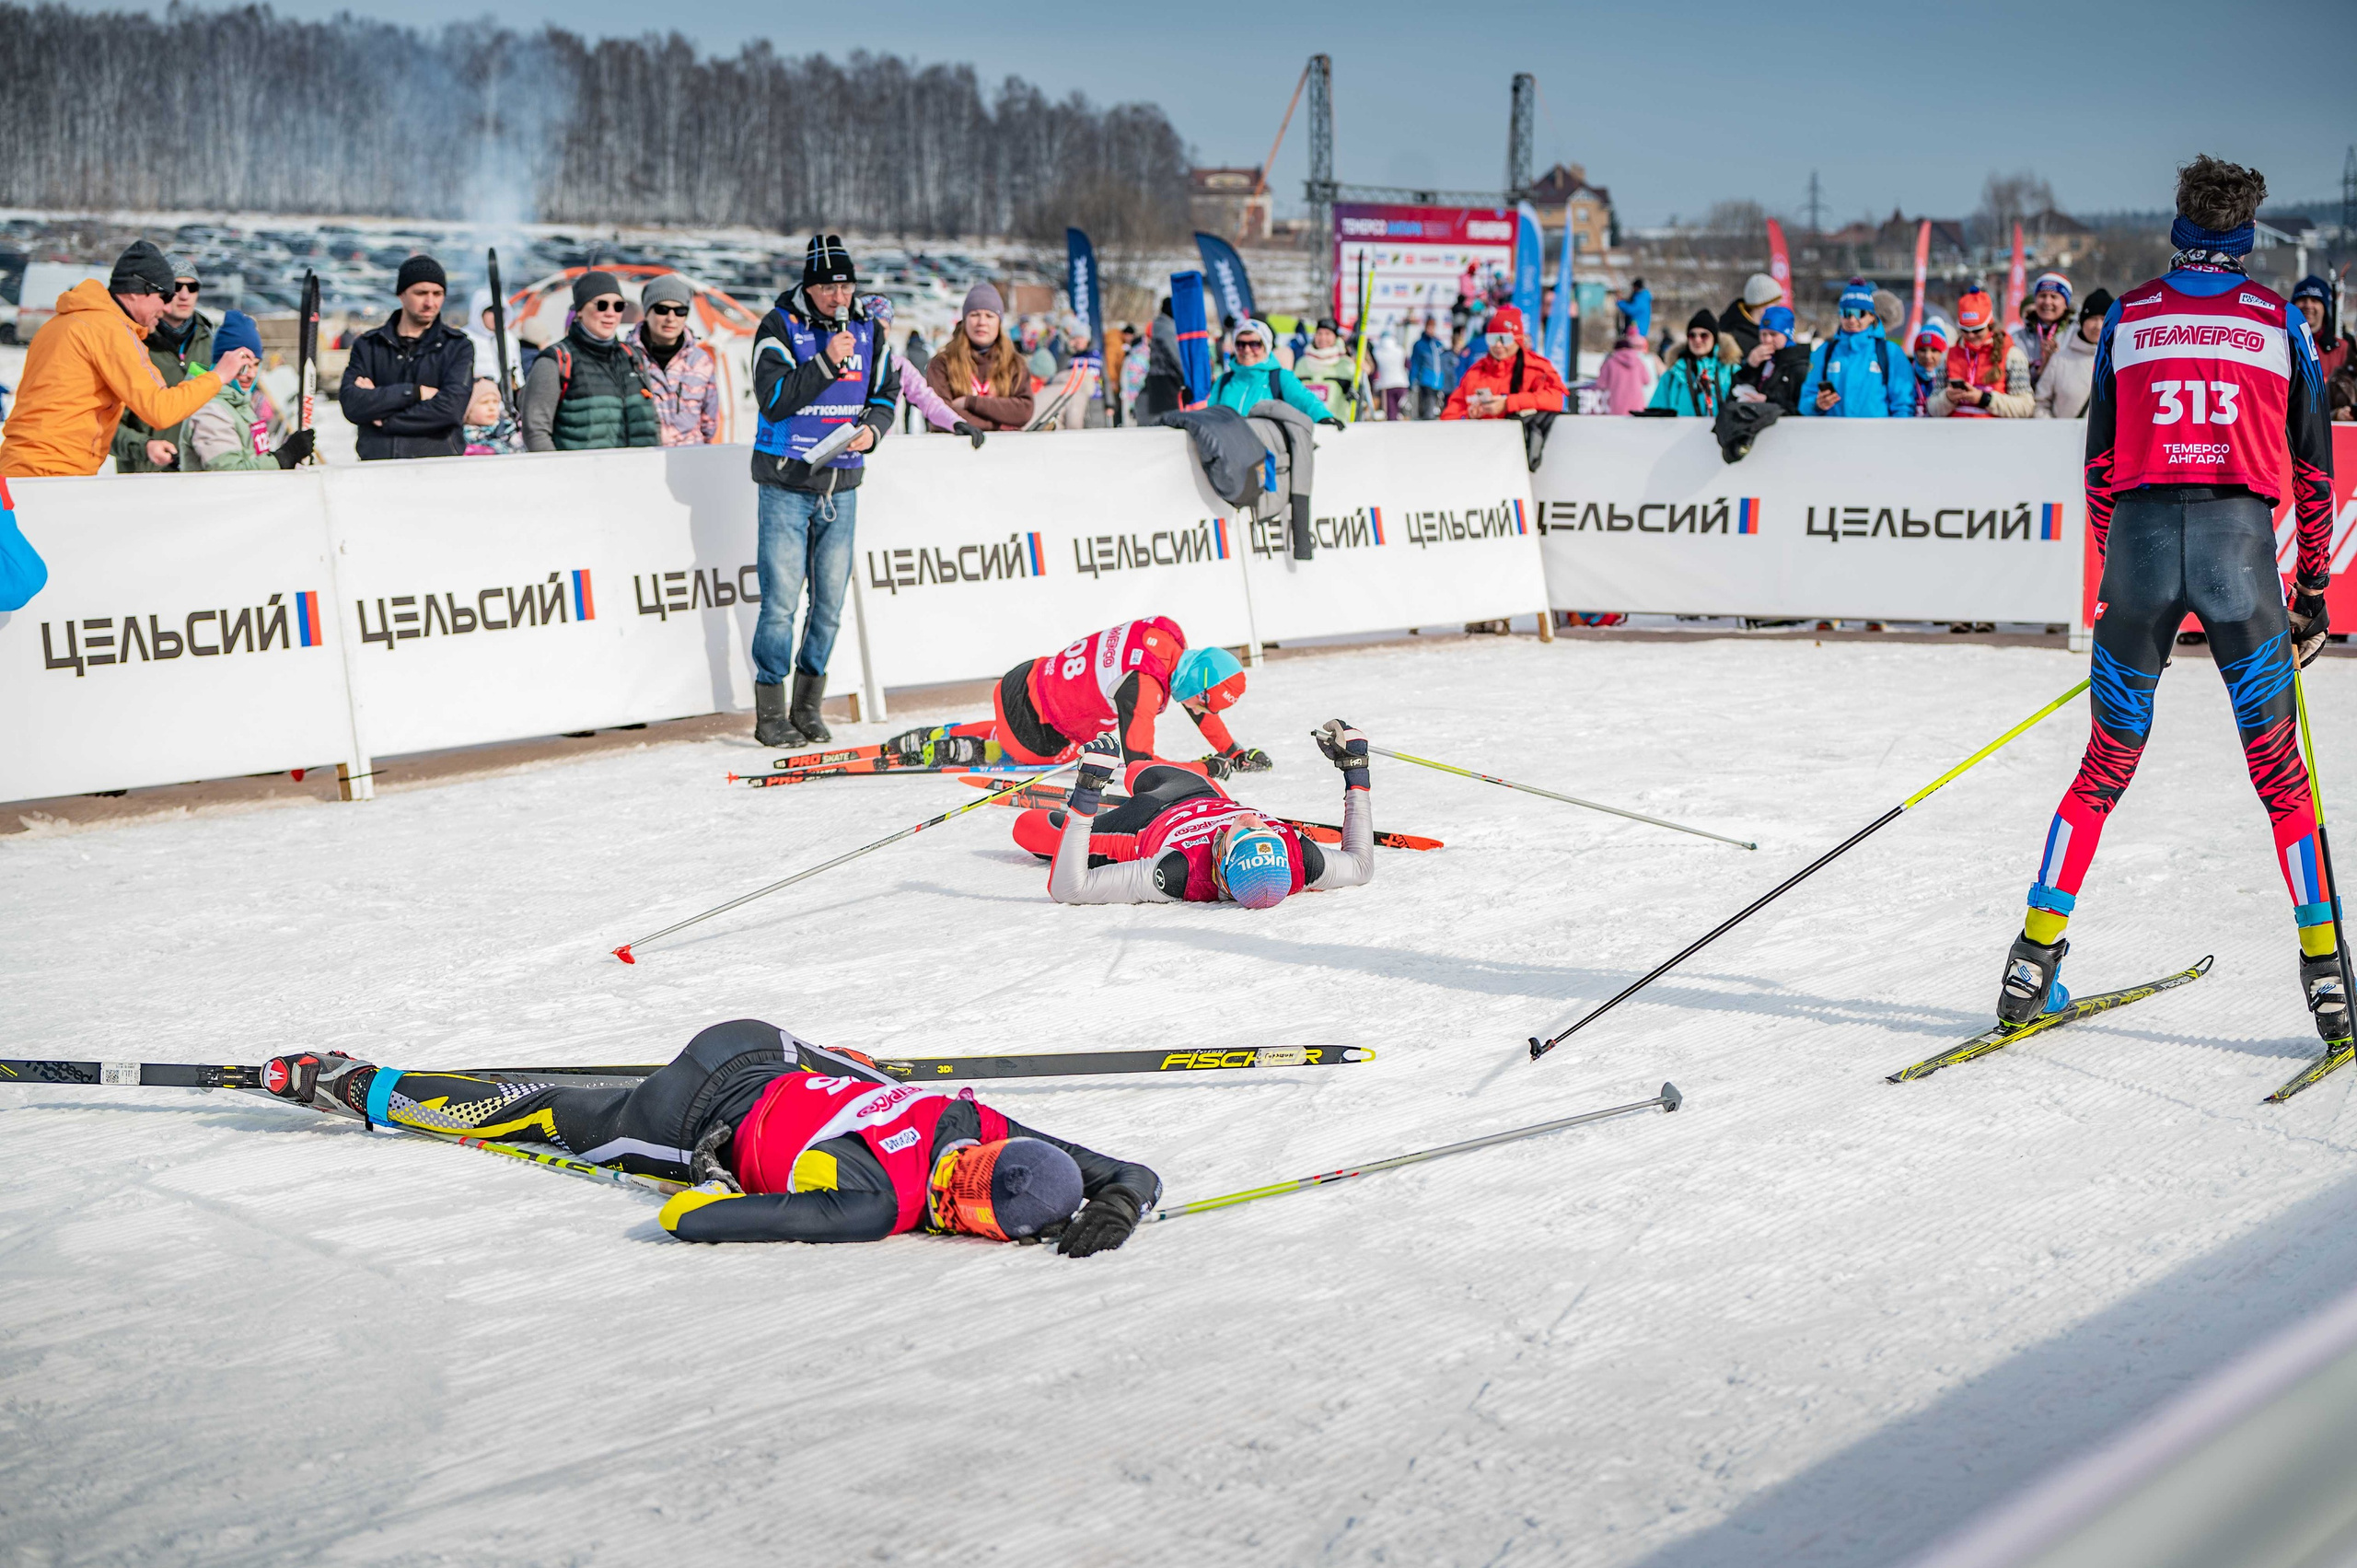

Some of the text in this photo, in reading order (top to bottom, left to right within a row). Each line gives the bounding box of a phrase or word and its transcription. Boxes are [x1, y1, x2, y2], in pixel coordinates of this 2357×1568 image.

[2133, 324, 2265, 353] ТЕМЕРСО
[2151, 380, 2240, 425] 313
[2163, 443, 2230, 454] ТЕМЕРСО
[2167, 454, 2225, 465] АНГАРА
[1250, 508, 1369, 560] ЦЕСИЙ
[1406, 500, 1514, 549] ЦЕЛЬСИЙ
[1806, 503, 2031, 542] ЦЕЛЬСИЙ
[867, 533, 1026, 595] ЦЕЛЬСИЙ
[1074, 519, 1212, 579] ЦЕЛЬСИЙ
[356, 572, 568, 650] ЦЕЛЬСИЙ
[633, 563, 761, 621] ЦЕЛЬС
[41, 593, 291, 678] ЦЕЛЬСИЙ
[788, 754, 821, 769] PRO
[821, 752, 850, 763] SKATE
[1237, 854, 1289, 871] LUKOIL
